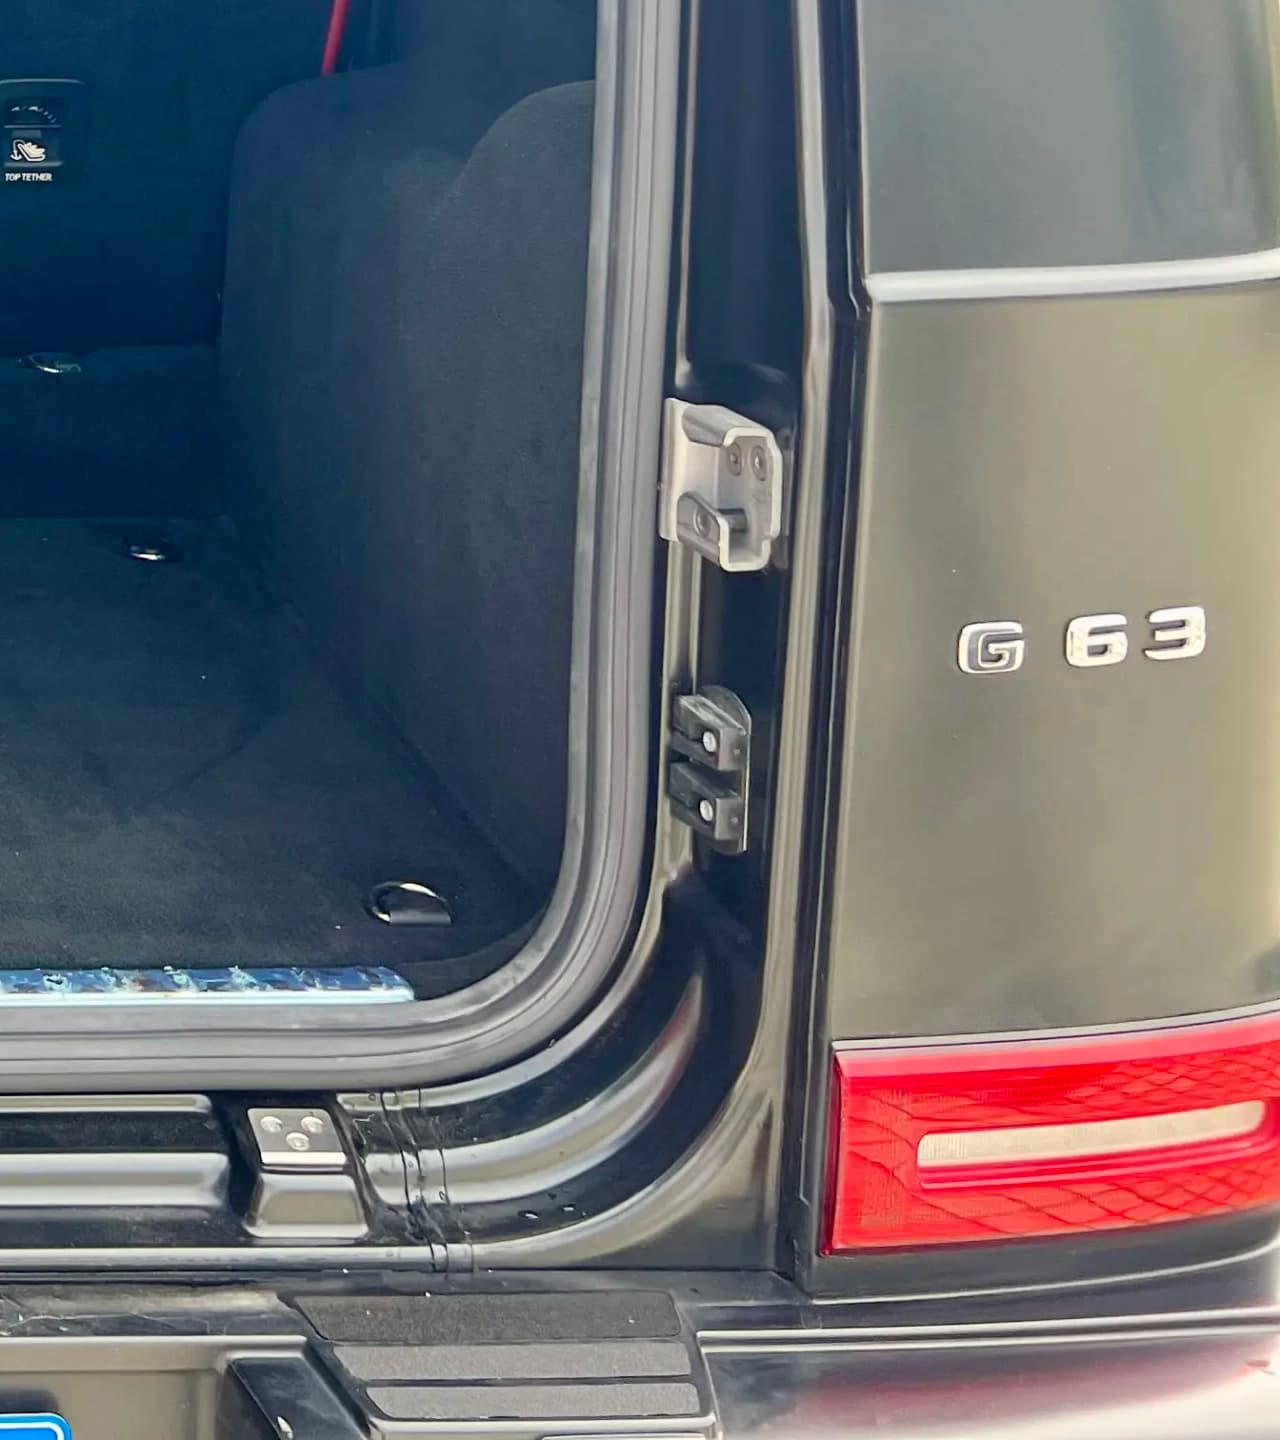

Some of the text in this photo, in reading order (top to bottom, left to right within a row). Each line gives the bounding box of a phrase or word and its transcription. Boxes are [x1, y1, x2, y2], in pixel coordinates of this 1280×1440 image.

[5, 172, 53, 182] TOP TETHER
[957, 605, 1207, 674] G 63
